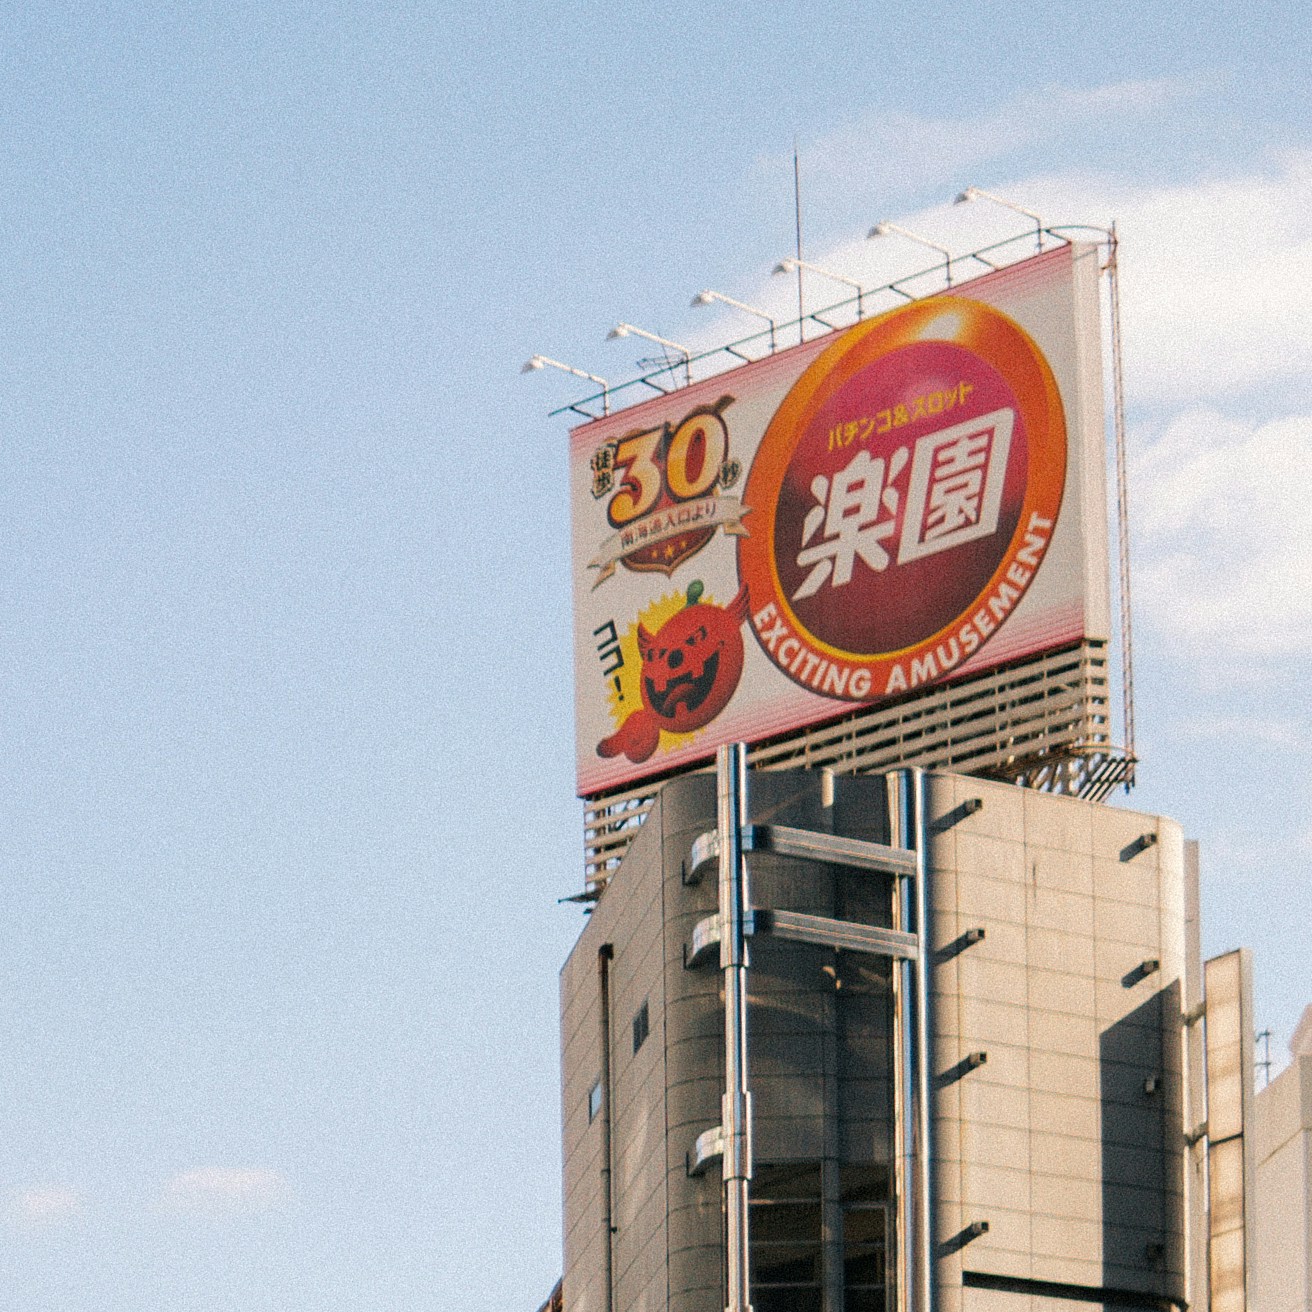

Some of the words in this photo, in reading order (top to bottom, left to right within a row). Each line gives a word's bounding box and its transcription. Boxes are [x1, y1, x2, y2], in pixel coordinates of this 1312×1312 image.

[609, 412, 726, 525] 30
[828, 381, 973, 451] パチンコ&スロット
[791, 407, 1015, 600] 楽園
[753, 603, 871, 697] EXCITING
[886, 511, 1054, 695] AMUSEMENT
